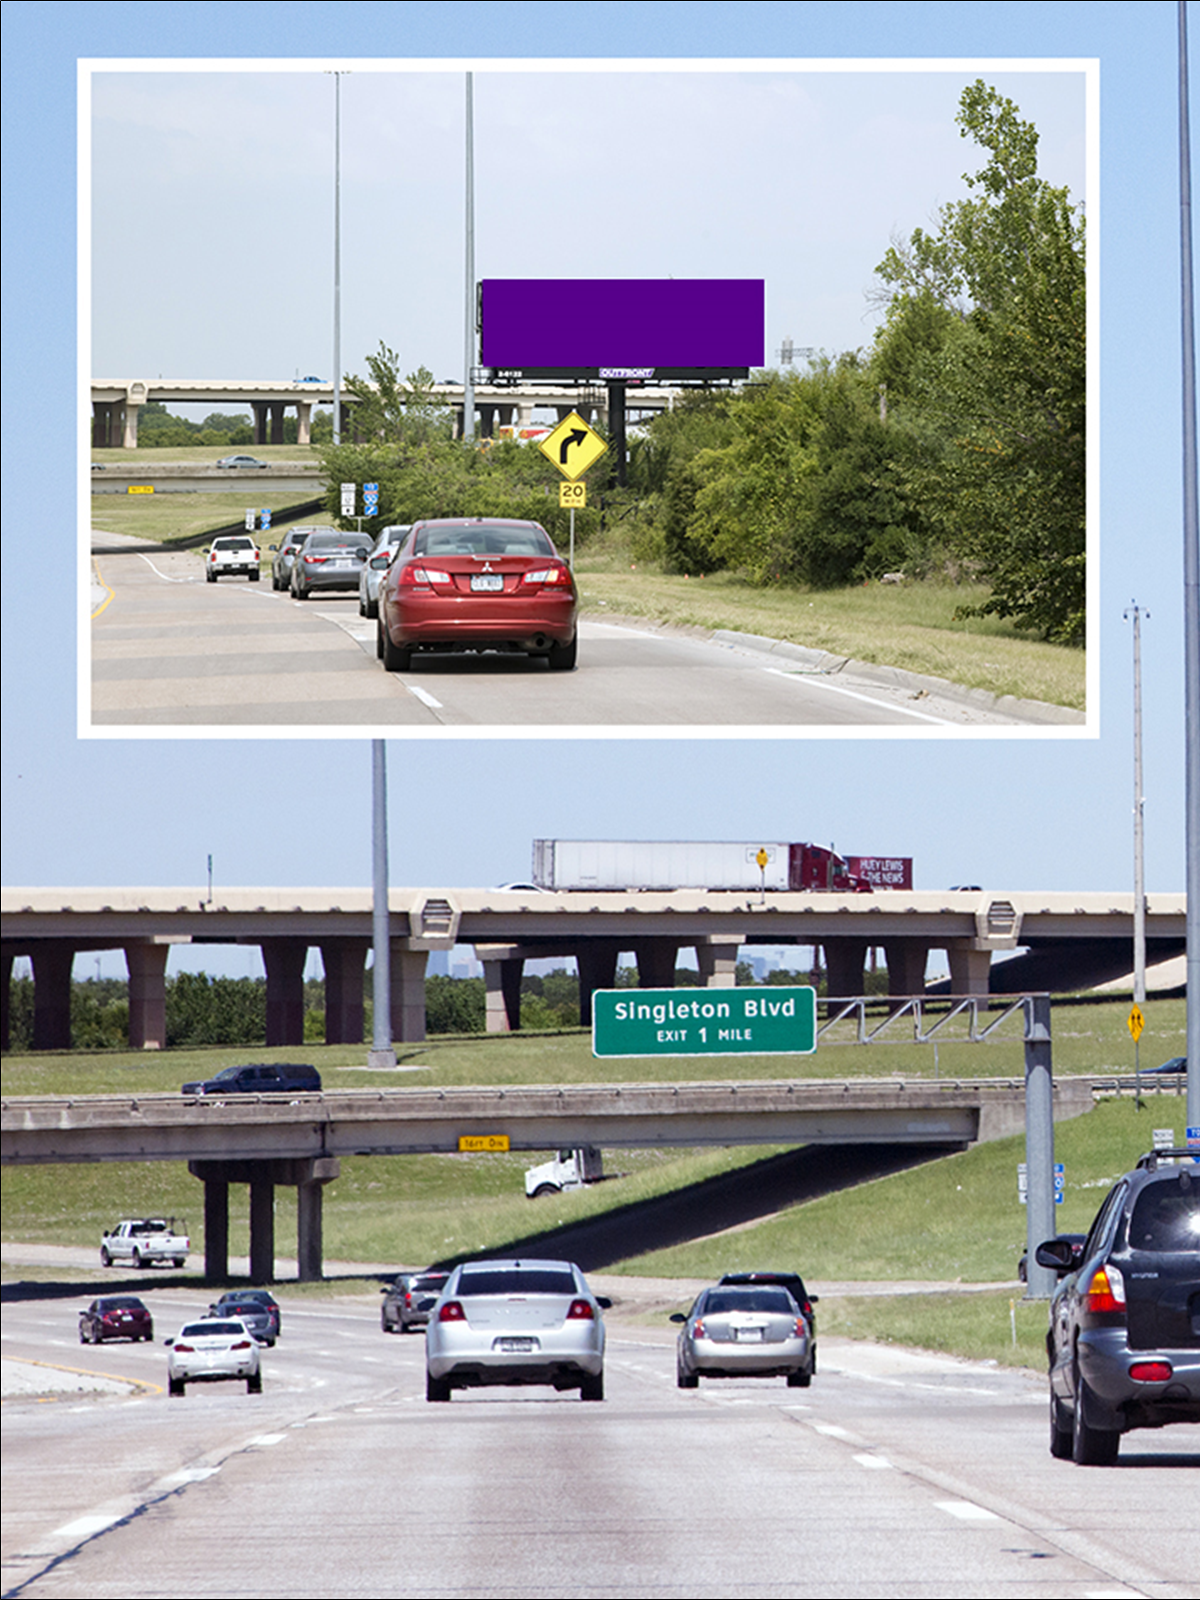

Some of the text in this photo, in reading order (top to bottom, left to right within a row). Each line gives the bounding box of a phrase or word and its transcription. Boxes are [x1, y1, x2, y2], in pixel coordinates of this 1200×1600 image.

[563, 485, 584, 498] 20
[860, 859, 904, 871] HUEY LEWIS
[867, 871, 881, 883] THE
[882, 871, 904, 884] NEWS
[614, 998, 795, 1024] Singleton Blvd
[656, 1027, 752, 1043] EXIT 1 MILE
